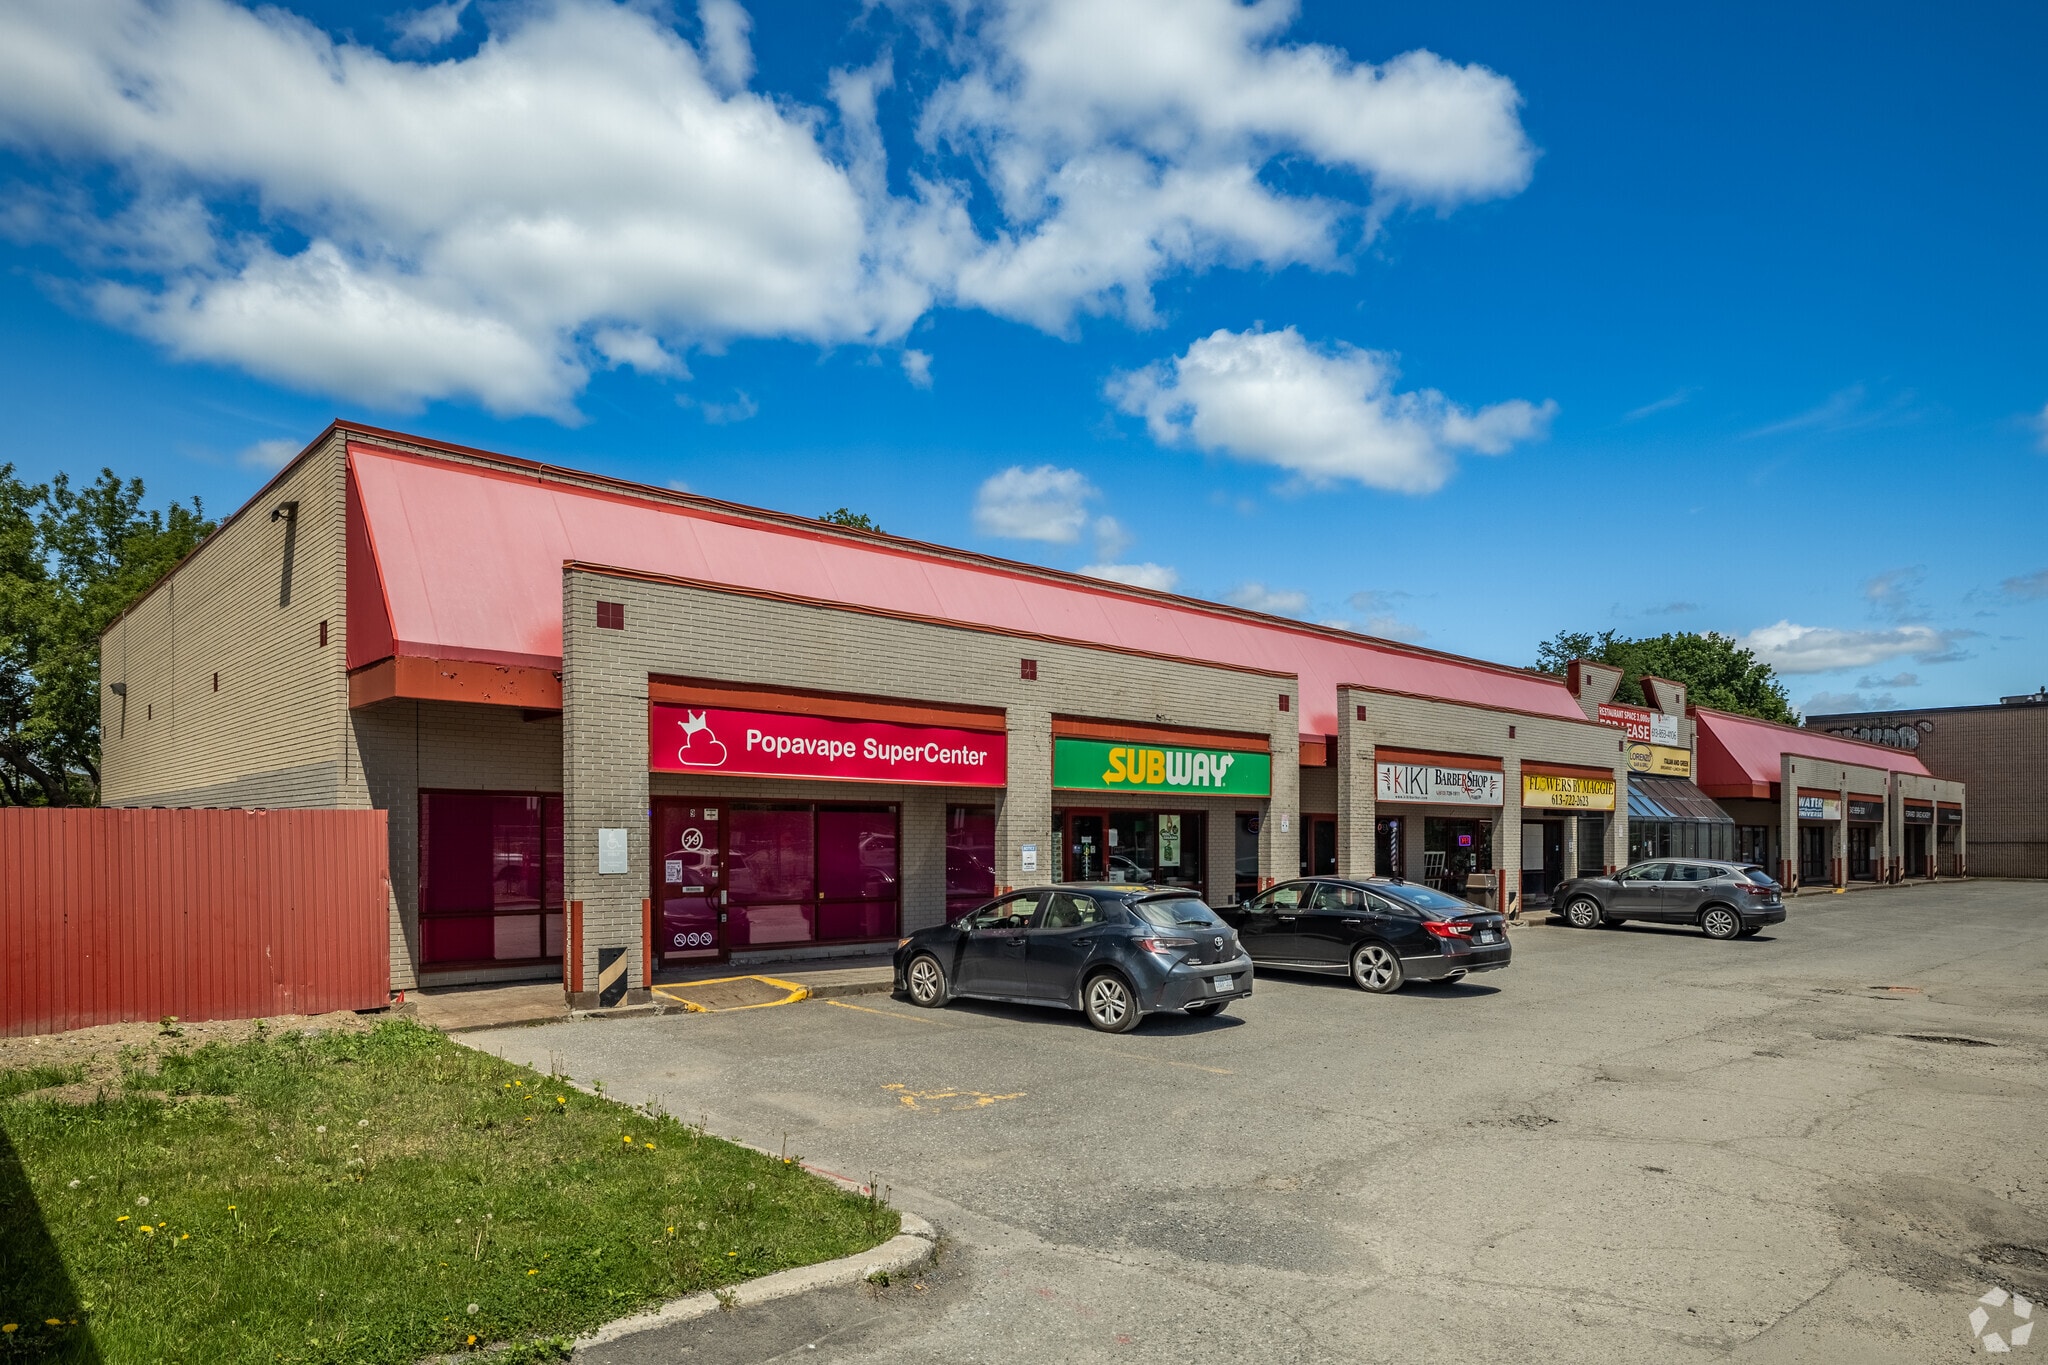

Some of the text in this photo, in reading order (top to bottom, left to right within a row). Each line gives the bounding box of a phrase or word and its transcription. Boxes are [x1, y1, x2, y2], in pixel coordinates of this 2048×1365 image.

[746, 729, 988, 766] Popavape SuperCenter
[1102, 747, 1235, 787] SUBWAY
[1529, 776, 1614, 795] FLOWERS BY MAGGIE
[1798, 797, 1823, 807] WATER
